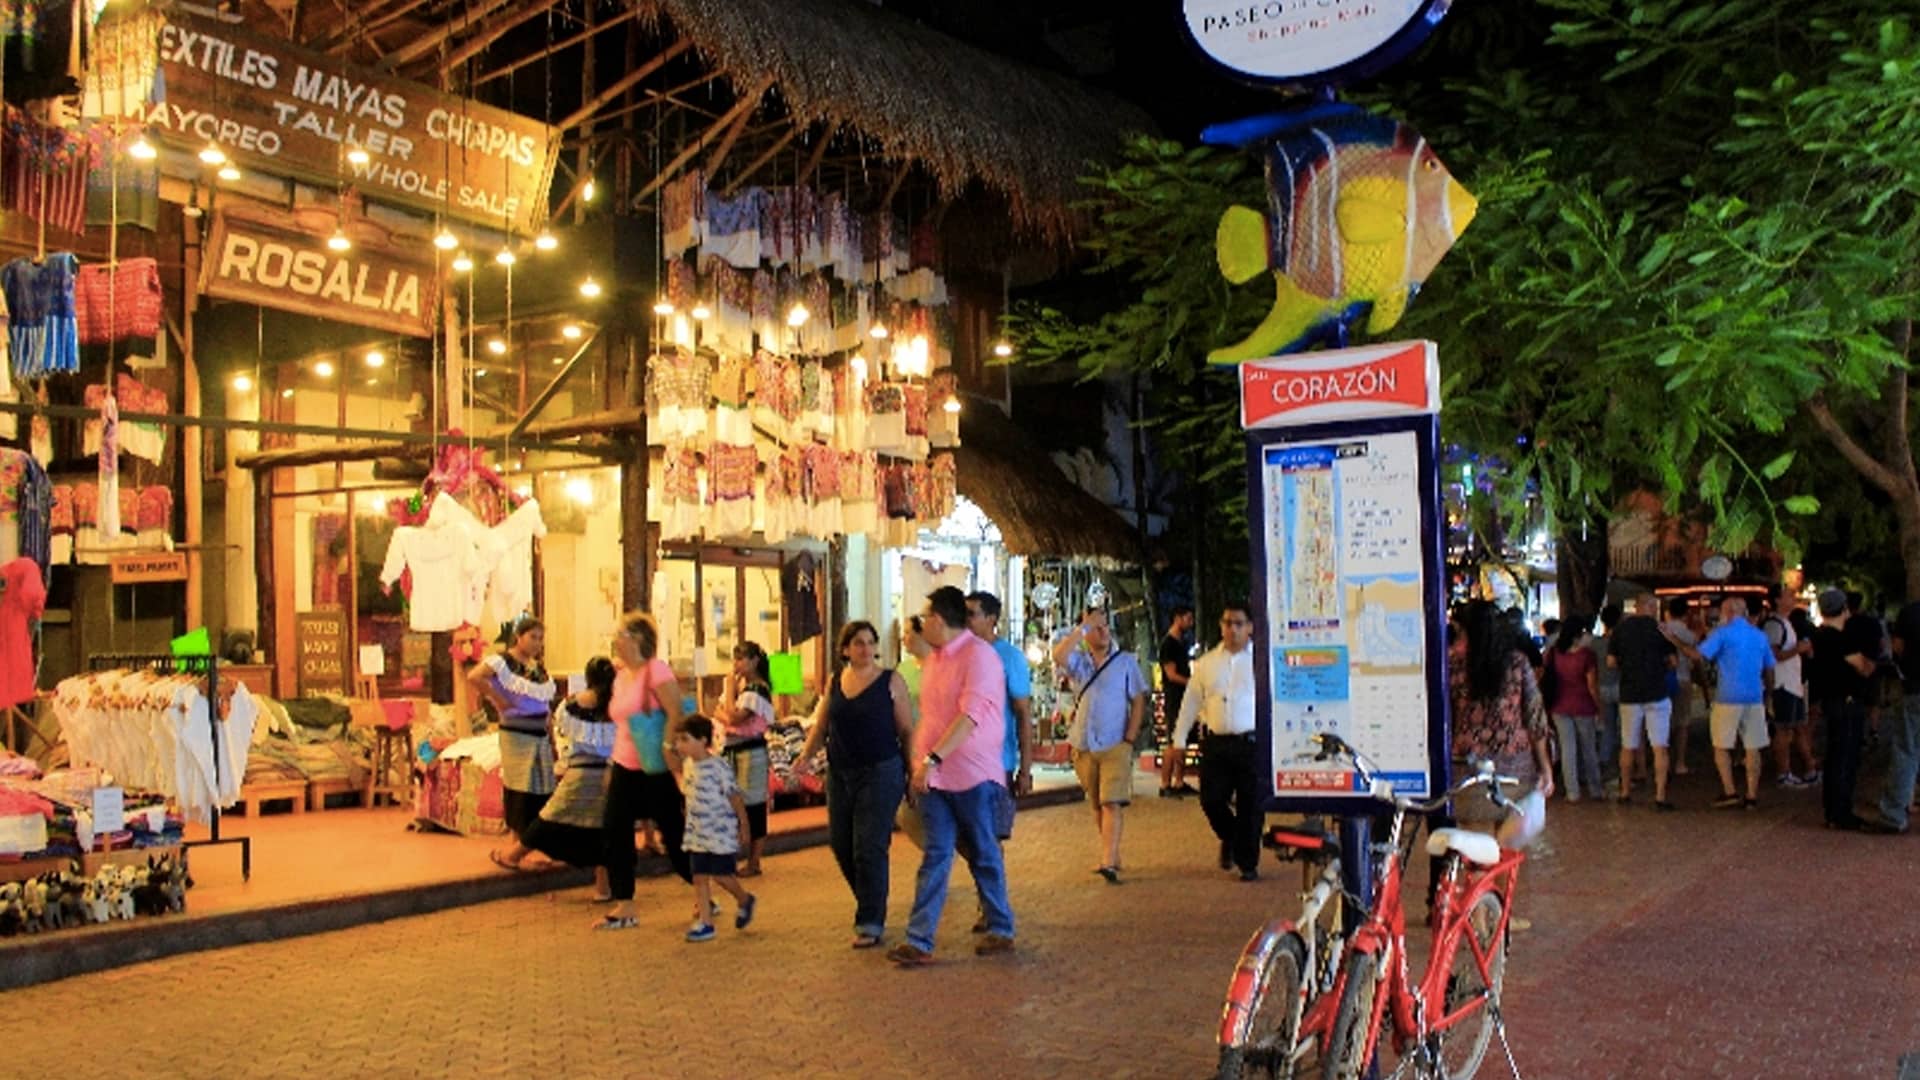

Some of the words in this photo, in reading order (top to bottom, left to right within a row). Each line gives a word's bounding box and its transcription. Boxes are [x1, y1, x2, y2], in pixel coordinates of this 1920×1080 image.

[1203, 1, 1283, 34] PASEO
[160, 24, 279, 90] EXTILES
[292, 66, 407, 129] MAYAS
[426, 108, 535, 167] CHIAPAS
[272, 102, 414, 161] TALLER
[351, 161, 452, 201] WHOLE
[457, 186, 521, 219] SALE
[219, 233, 420, 317] ROSALIA
[1271, 365, 1398, 404] CORAZÓN
